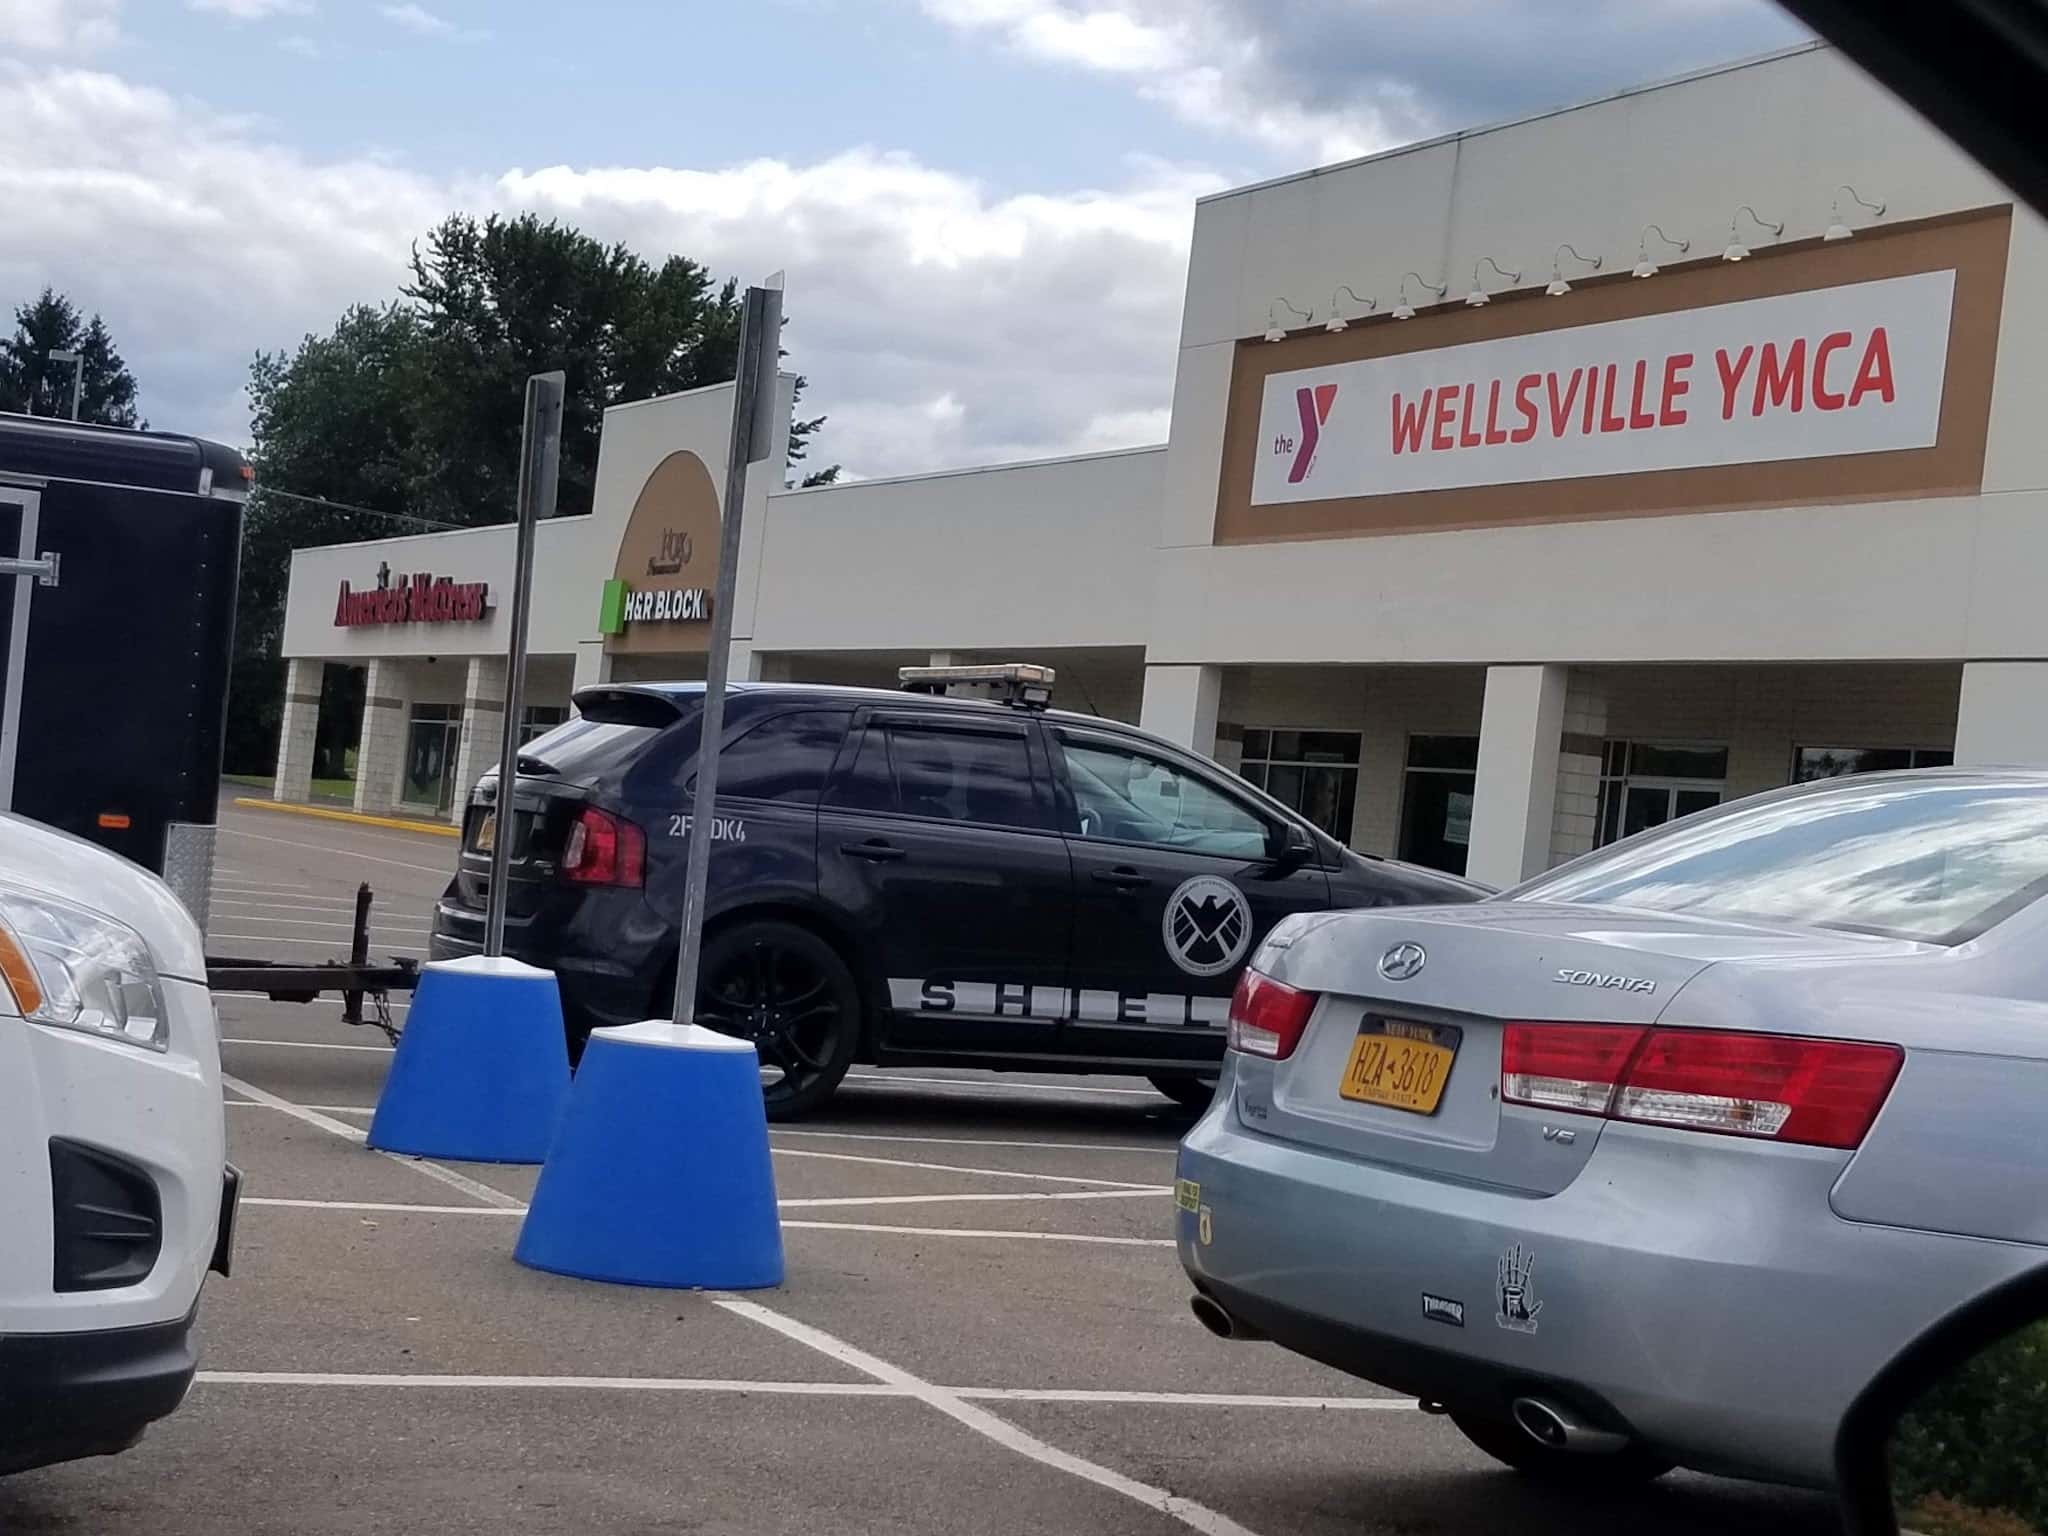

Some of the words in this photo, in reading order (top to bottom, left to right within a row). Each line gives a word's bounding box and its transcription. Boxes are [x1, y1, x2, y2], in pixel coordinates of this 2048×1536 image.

[1392, 353, 1694, 455] WELLSVILLE
[1715, 327, 1895, 420] YMCA
[1274, 434, 1293, 455] the
[624, 591, 654, 621] H&R
[655, 588, 704, 620] BLOCK
[668, 814, 746, 842] 2FDK4
[1551, 967, 1657, 995] SONATA
[920, 979, 1211, 1027] SHIEL
